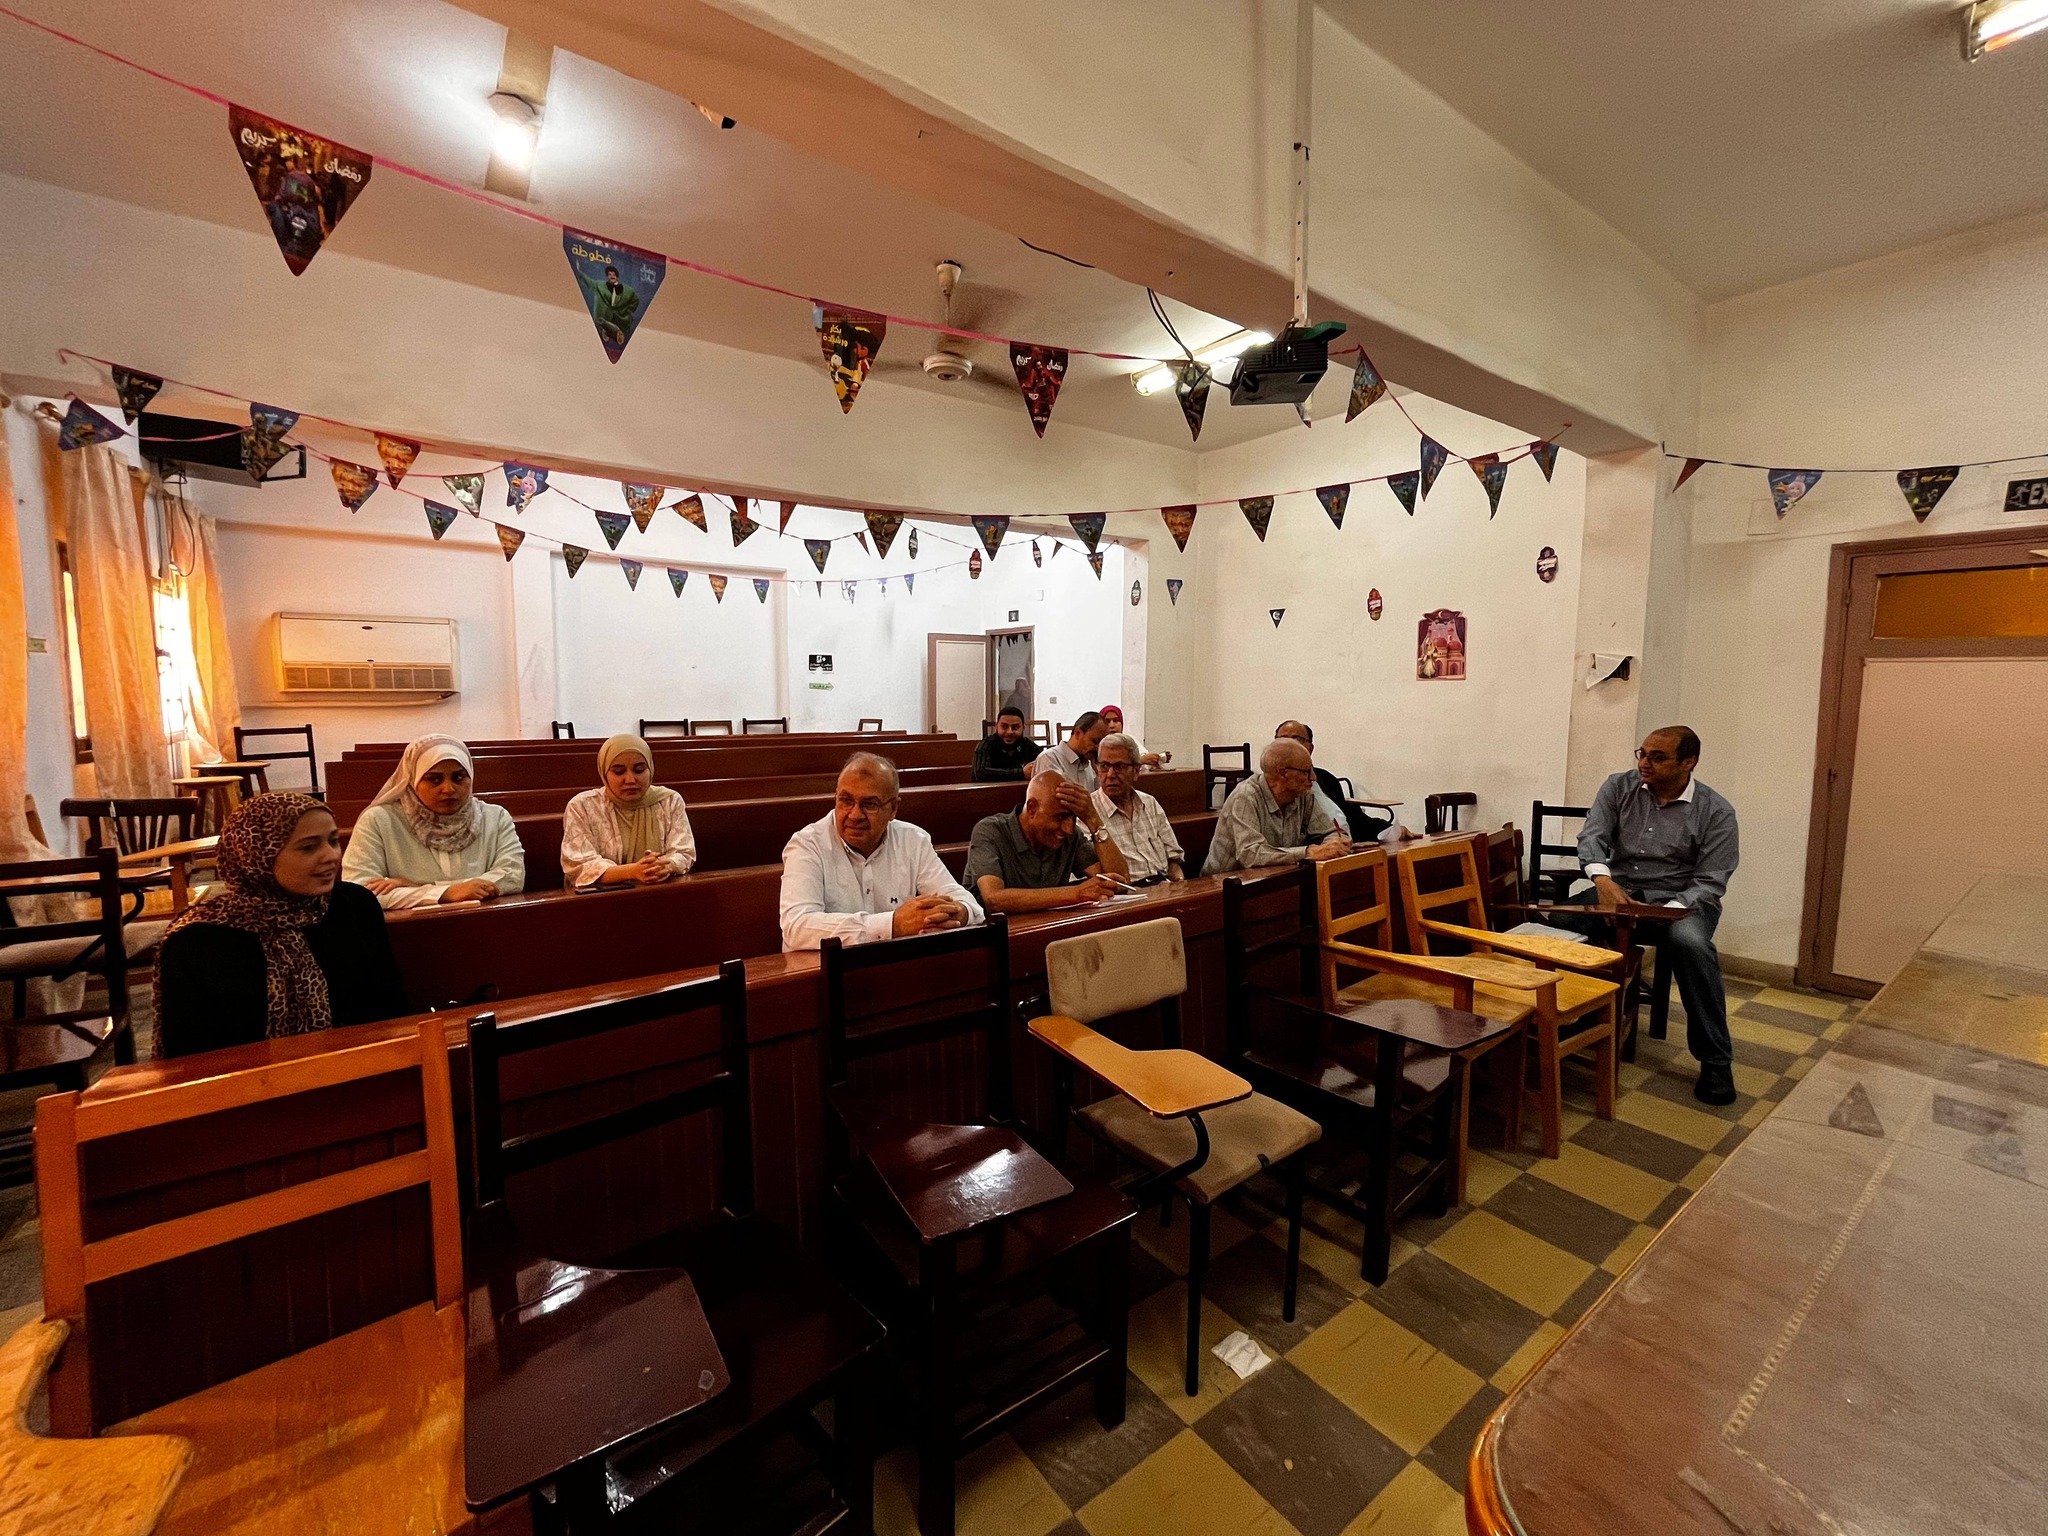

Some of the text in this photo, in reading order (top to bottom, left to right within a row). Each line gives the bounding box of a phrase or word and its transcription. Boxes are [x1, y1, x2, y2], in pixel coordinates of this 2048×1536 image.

[240, 127, 361, 182] رمضان كريم
[571, 243, 612, 265] فطوطة
[1046, 359, 1064, 372] رمضان
